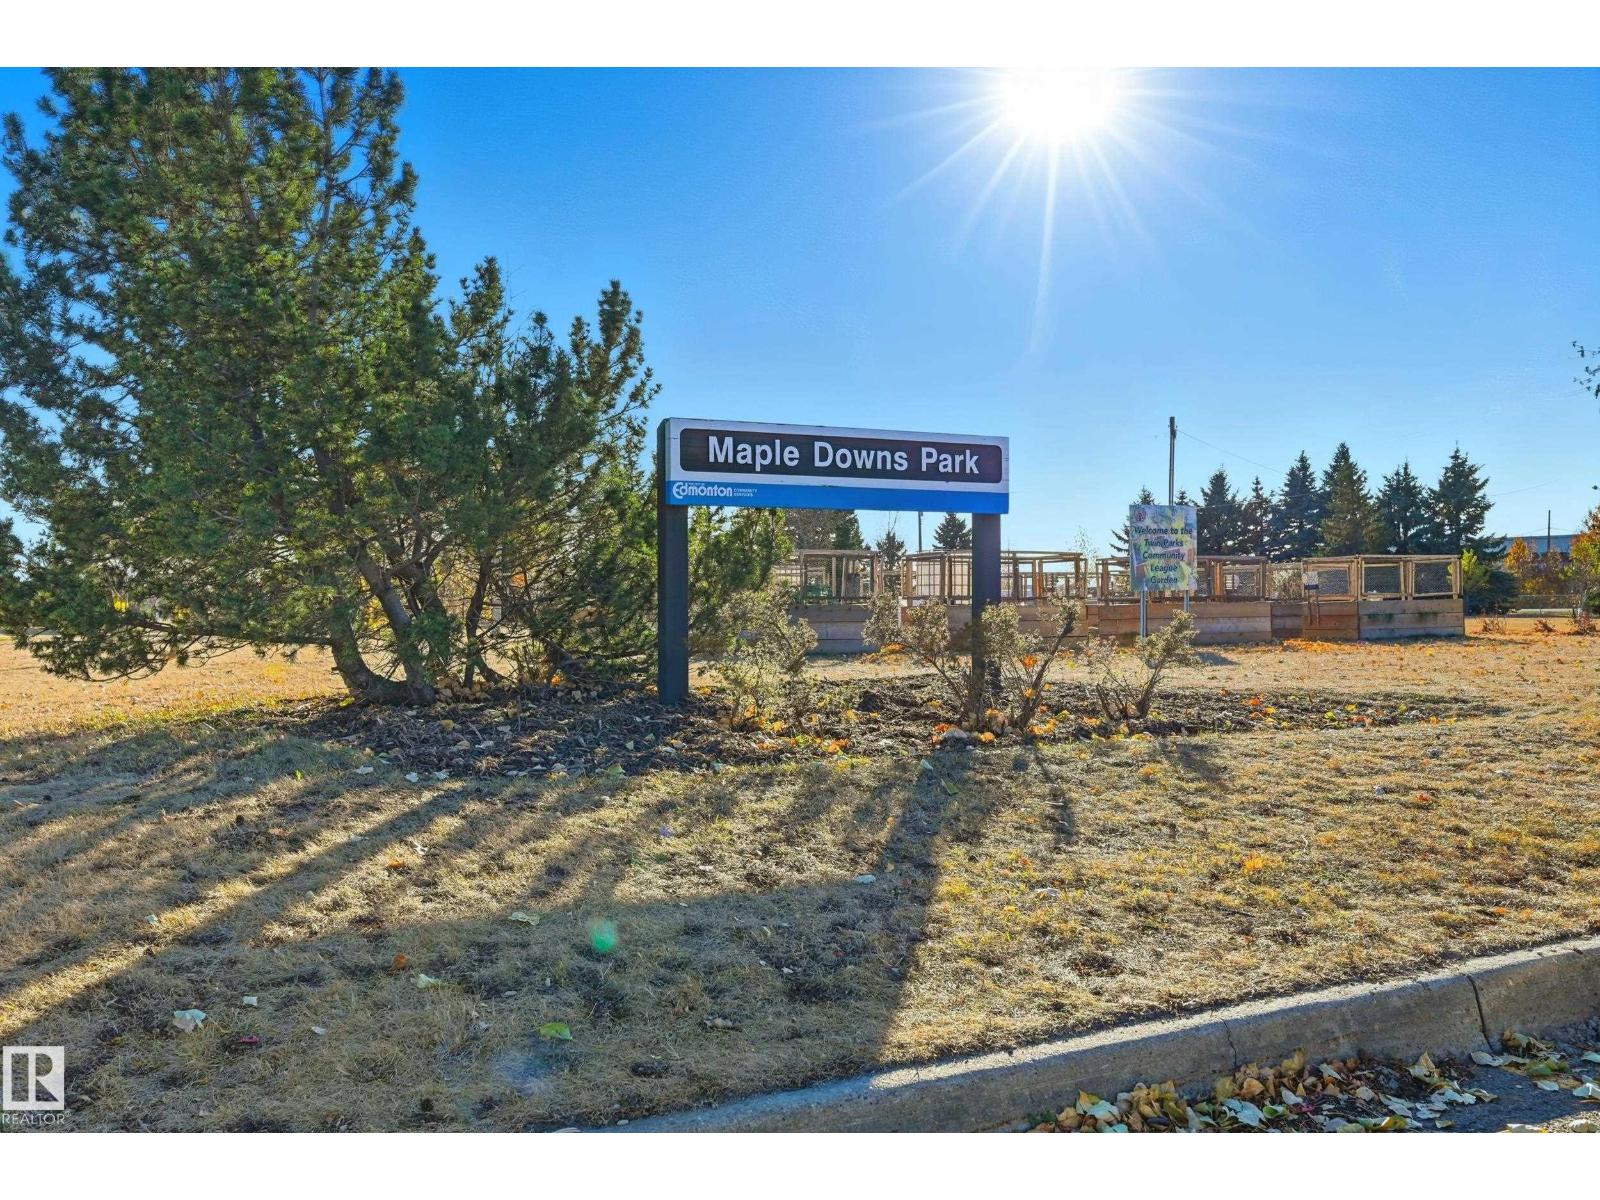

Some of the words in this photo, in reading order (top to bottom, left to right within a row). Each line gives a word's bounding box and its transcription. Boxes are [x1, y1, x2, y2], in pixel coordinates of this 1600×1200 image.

[708, 436, 800, 471] Maple
[814, 441, 908, 471] Downs
[921, 447, 980, 474] Park
[672, 481, 733, 499] Edmonton
[1134, 526, 1168, 535] Welcome
[1170, 527, 1179, 535] to
[1180, 526, 1192, 535] the
[1144, 539, 1161, 547] Twin
[1163, 539, 1184, 547] Parks
[1142, 551, 1186, 561] Community
[1150, 564, 1178, 574] League
[1150, 576, 1178, 584] Garden
